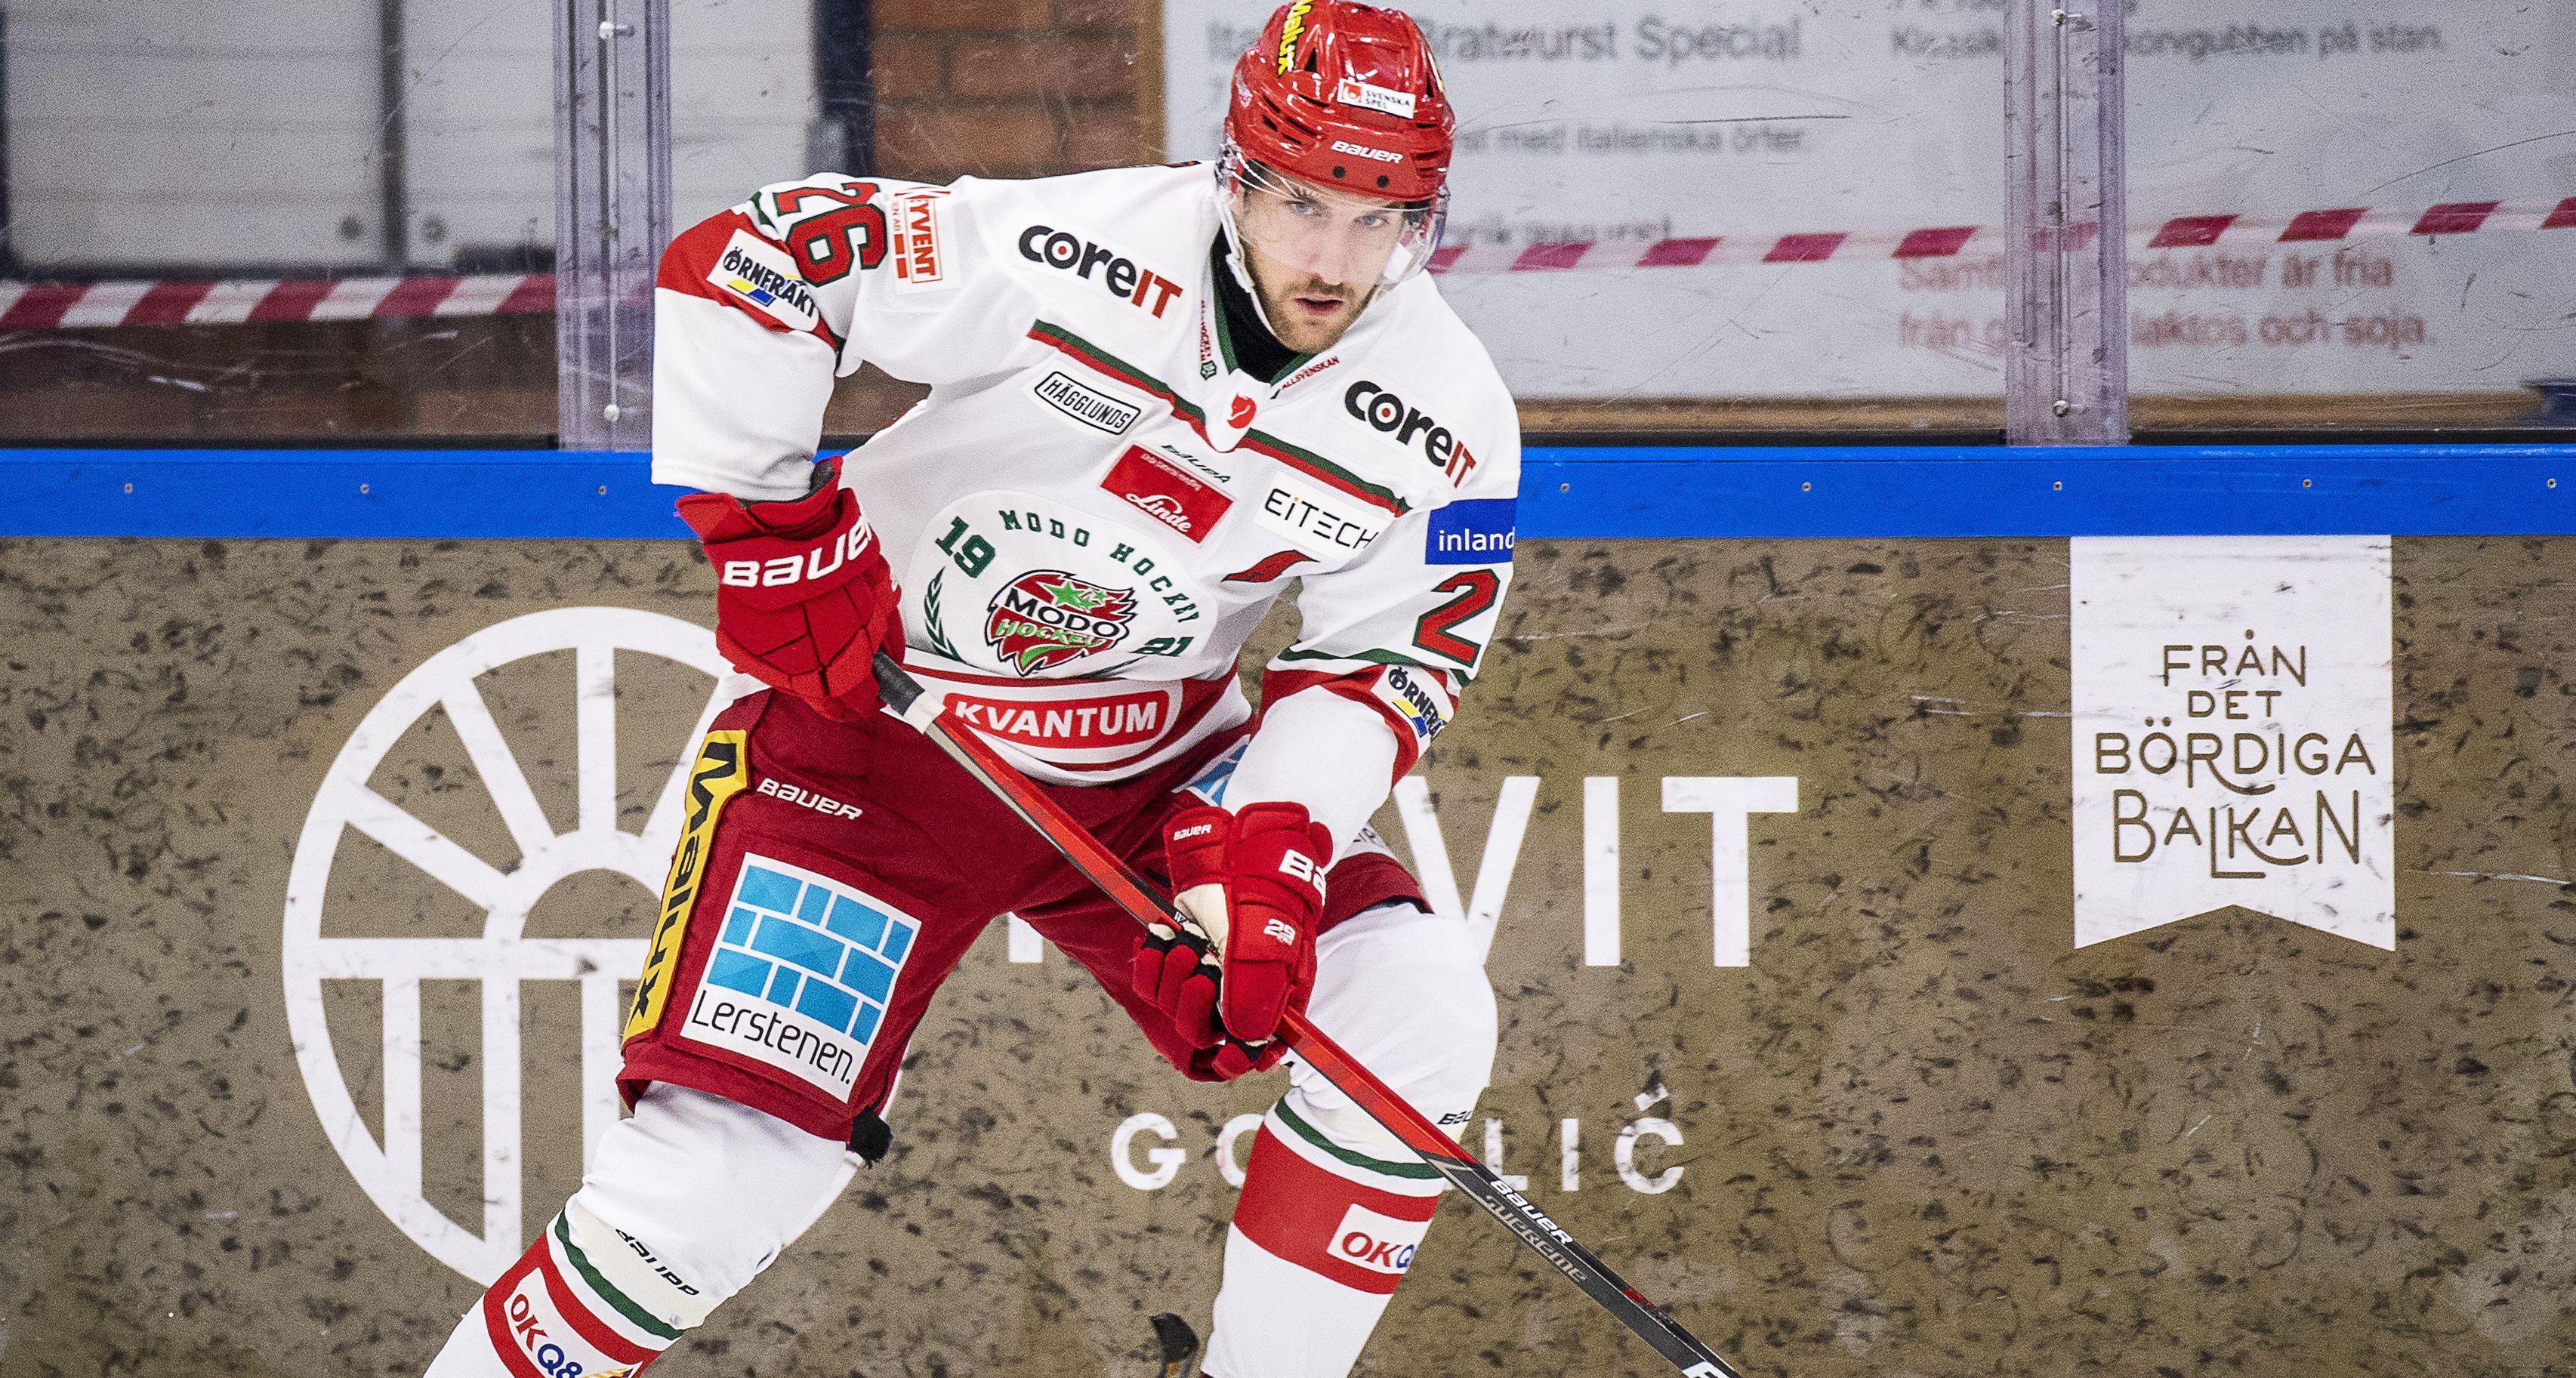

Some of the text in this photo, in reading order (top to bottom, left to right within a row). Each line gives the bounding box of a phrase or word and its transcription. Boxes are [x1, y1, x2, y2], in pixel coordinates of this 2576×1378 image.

[1637, 16, 1800, 70] Special
[2320, 24, 2359, 62] på
[1365, 90, 1410, 106] SVENSKA
[1365, 97, 1388, 109] SPEL
[773, 182, 889, 288] 26
[723, 245, 816, 318] ÖRNFRAKT
[2282, 254, 2318, 288] är
[2333, 249, 2394, 288] fria
[2260, 307, 2330, 345] och
[1282, 356, 1340, 390] ALLSVENSKAN
[1044, 381, 1131, 429] HÄGGLUNDS
[1125, 493, 1192, 533] Linde
[935, 516, 996, 578] 19
[999, 510, 1199, 623] MODO HOCKEY
[995, 618, 1106, 648] HOCKEY
[1004, 588, 1121, 640] MODO
[1412, 569, 1501, 667] 2
[2164, 629, 2306, 687] FRÅN
[955, 701, 1157, 738] KVANTUM
[2188, 690, 2282, 720] DET
[2096, 717, 2376, 795] BÖRDIGA
[2113, 789, 2359, 878] BALKAN
[630, 741, 738, 1026] Malux
[1341, 1232, 1414, 1269] OKQ
